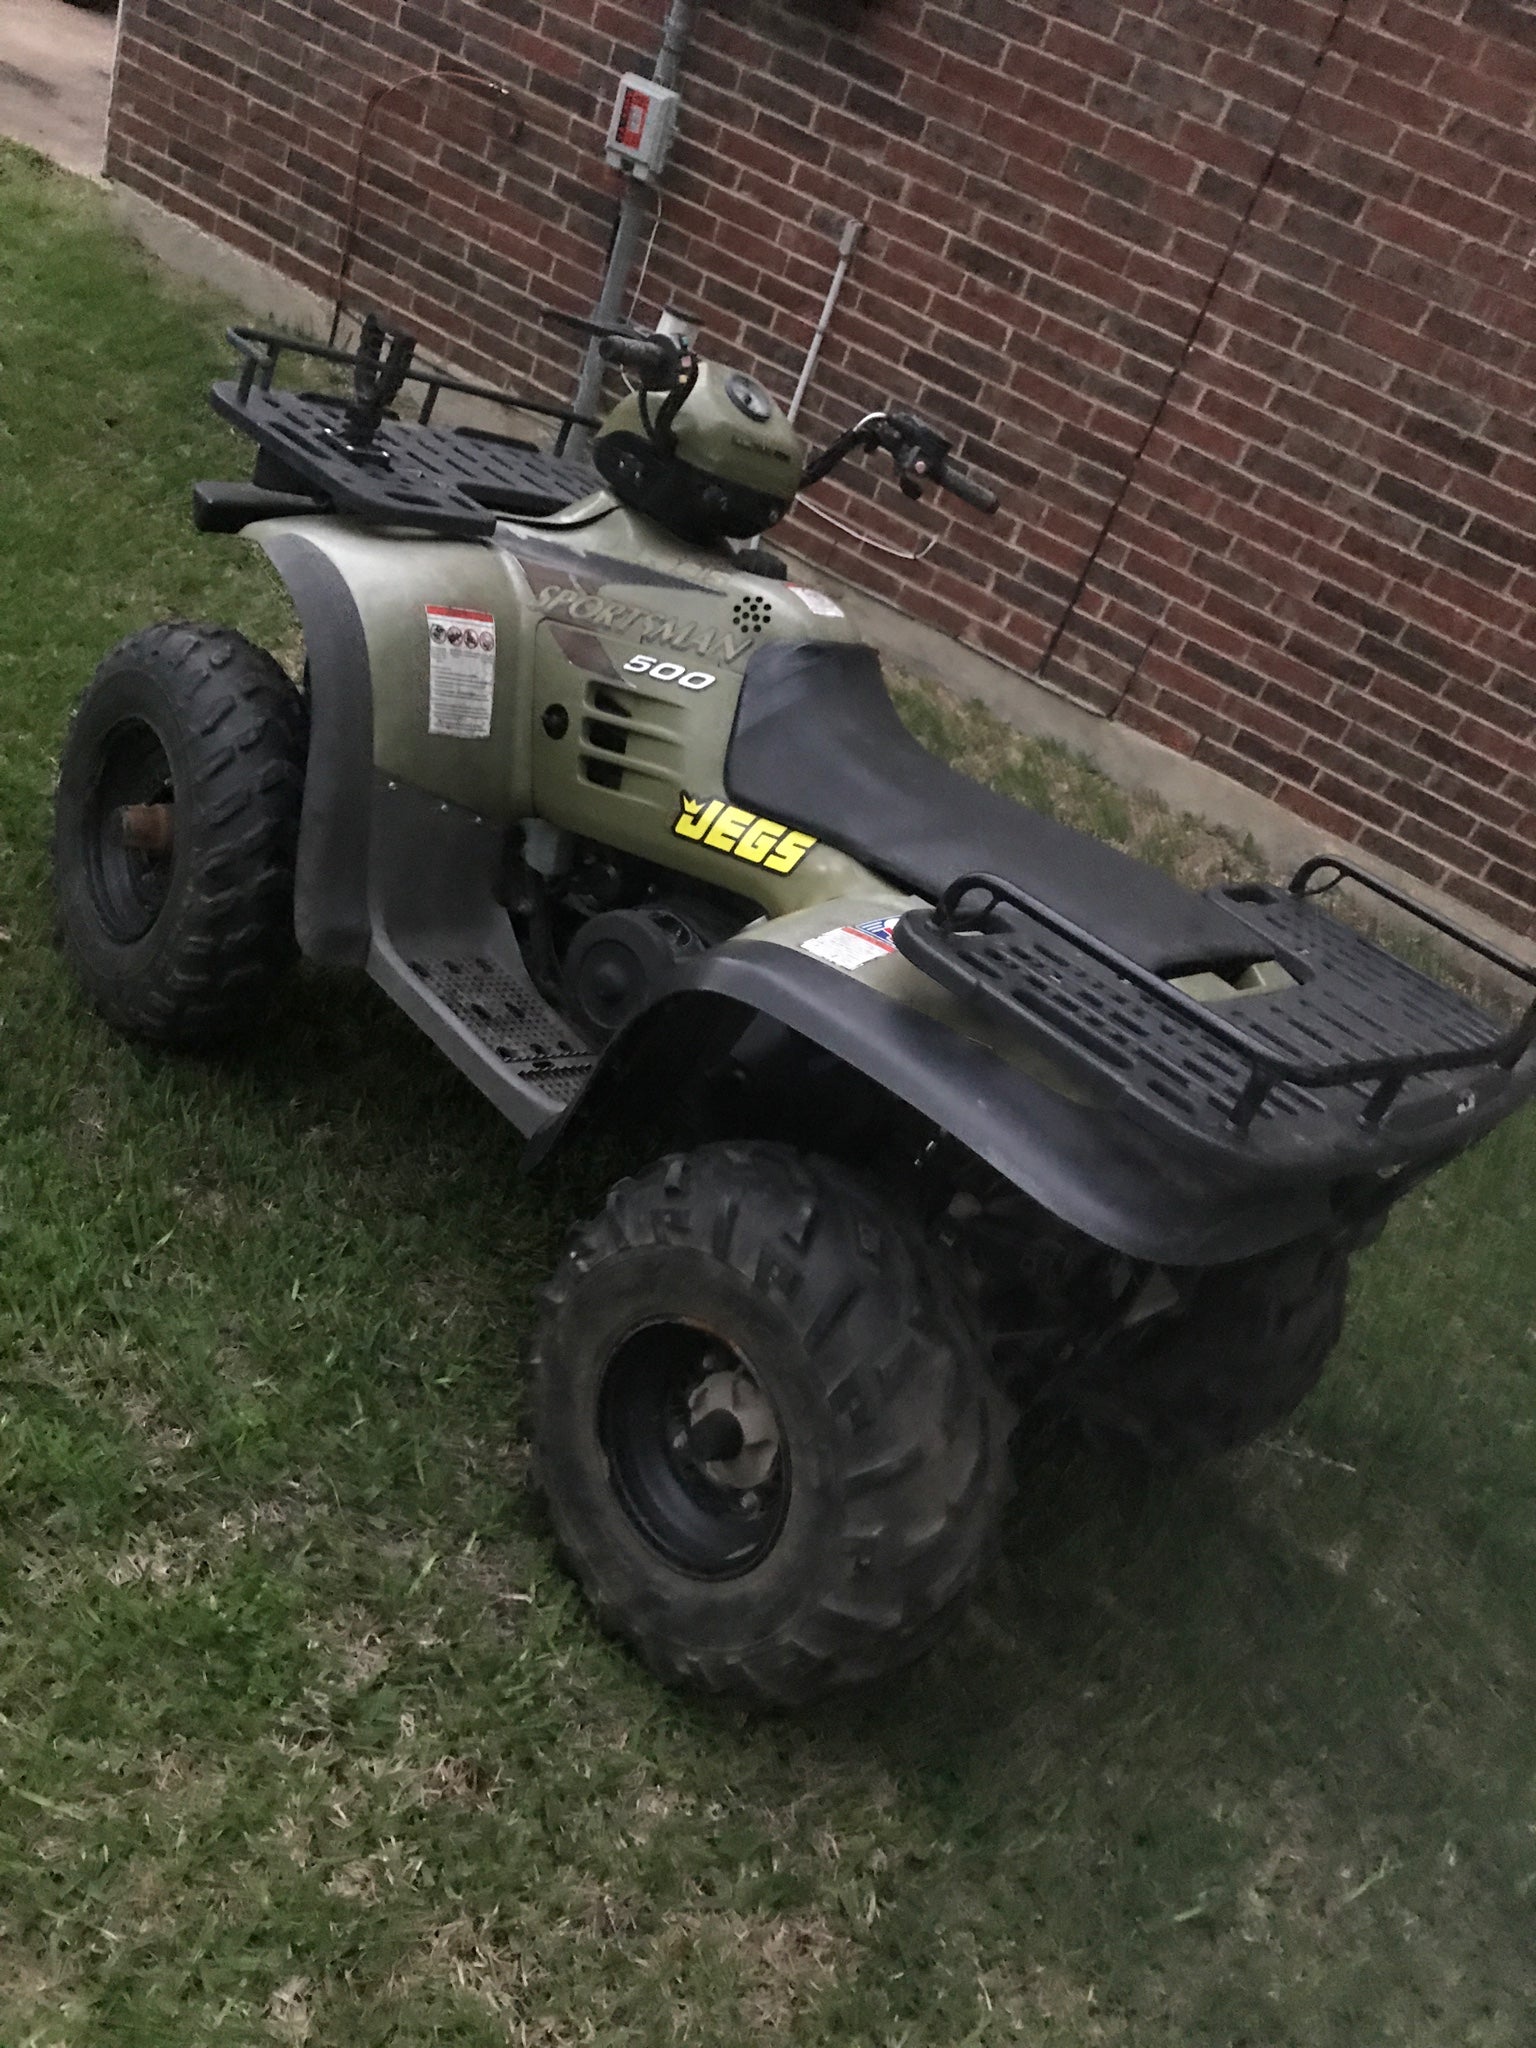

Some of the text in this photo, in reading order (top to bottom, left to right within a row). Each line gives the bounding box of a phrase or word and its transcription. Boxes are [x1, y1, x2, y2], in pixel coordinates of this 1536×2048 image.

[535, 586, 754, 663] SPORTSMAN
[623, 654, 716, 690] 500
[673, 797, 818, 874] JEGS
